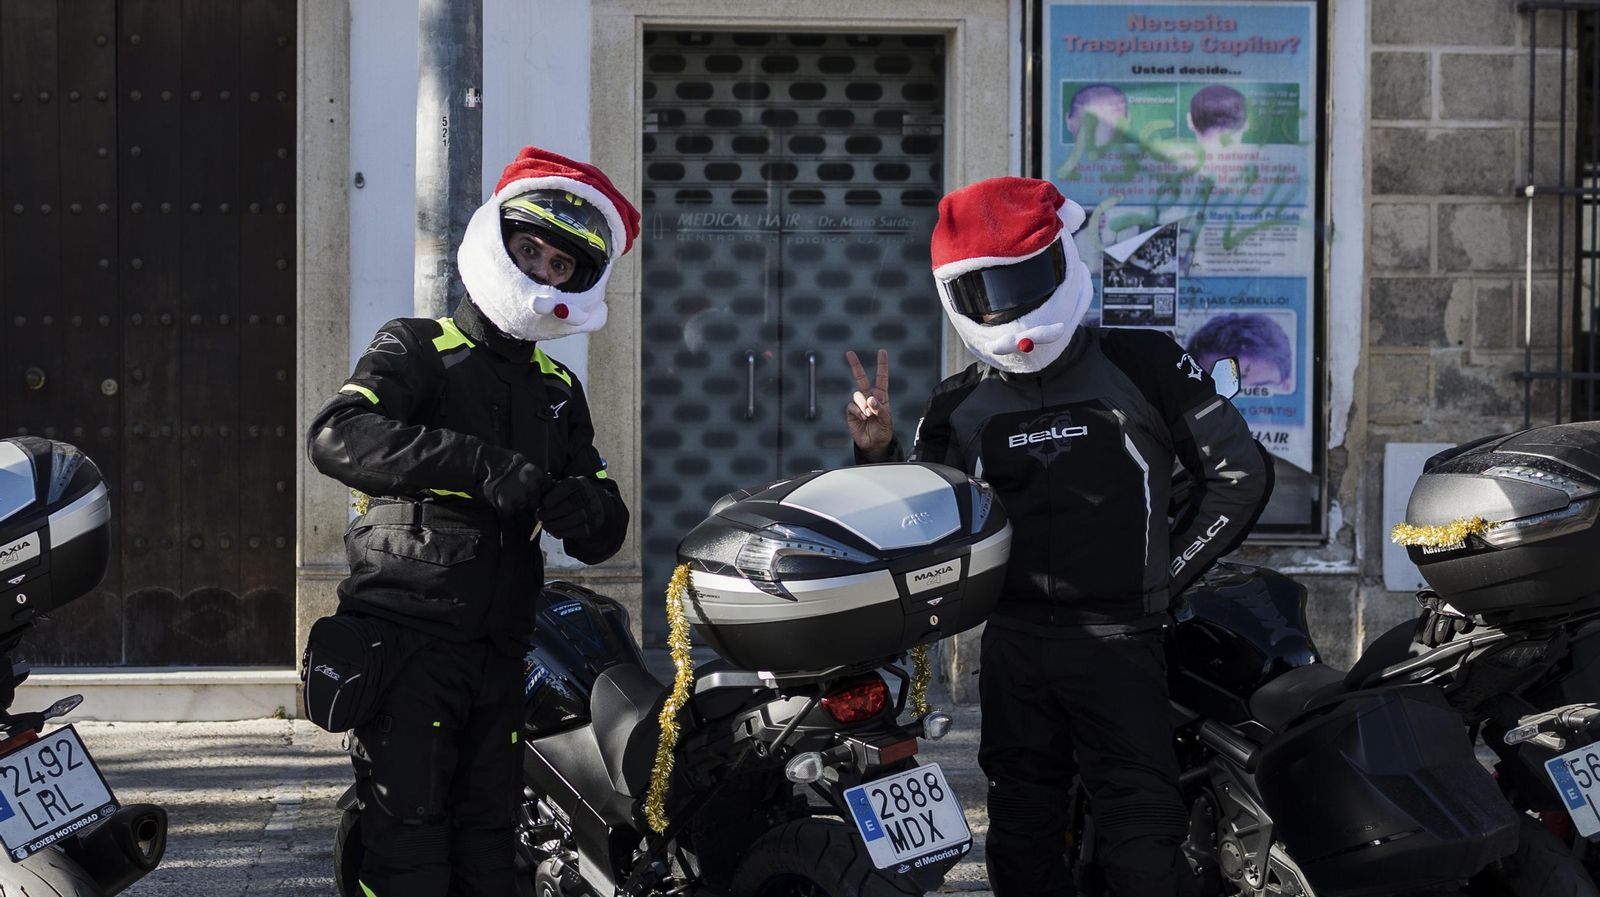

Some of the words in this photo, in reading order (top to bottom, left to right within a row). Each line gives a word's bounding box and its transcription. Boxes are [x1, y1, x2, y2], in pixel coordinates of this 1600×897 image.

[1126, 14, 1238, 33] Necesita
[1063, 35, 1194, 57] Trasplante
[1200, 35, 1301, 57] Capilar?
[1131, 65, 1175, 76] Usted
[1179, 65, 1242, 76] decide...
[677, 212, 752, 227] MEDICAL
[818, 214, 837, 228] Dr.
[1007, 425, 1088, 448] Bela
[1168, 514, 1230, 578] Bela
[914, 565, 953, 582] MAXIA
[560, 605, 582, 616] 650
[2, 739, 84, 798] 2492
[871, 772, 944, 820] 2888
[1567, 788, 1578, 800] E
[18, 783, 84, 831] LRL
[30, 834, 57, 852] BOXER
[56, 813, 99, 839] MOTORRAD
[865, 819, 875, 832] E
[885, 809, 945, 854] MDX
[914, 859, 923, 869] el
[923, 847, 960, 867] Motorista
